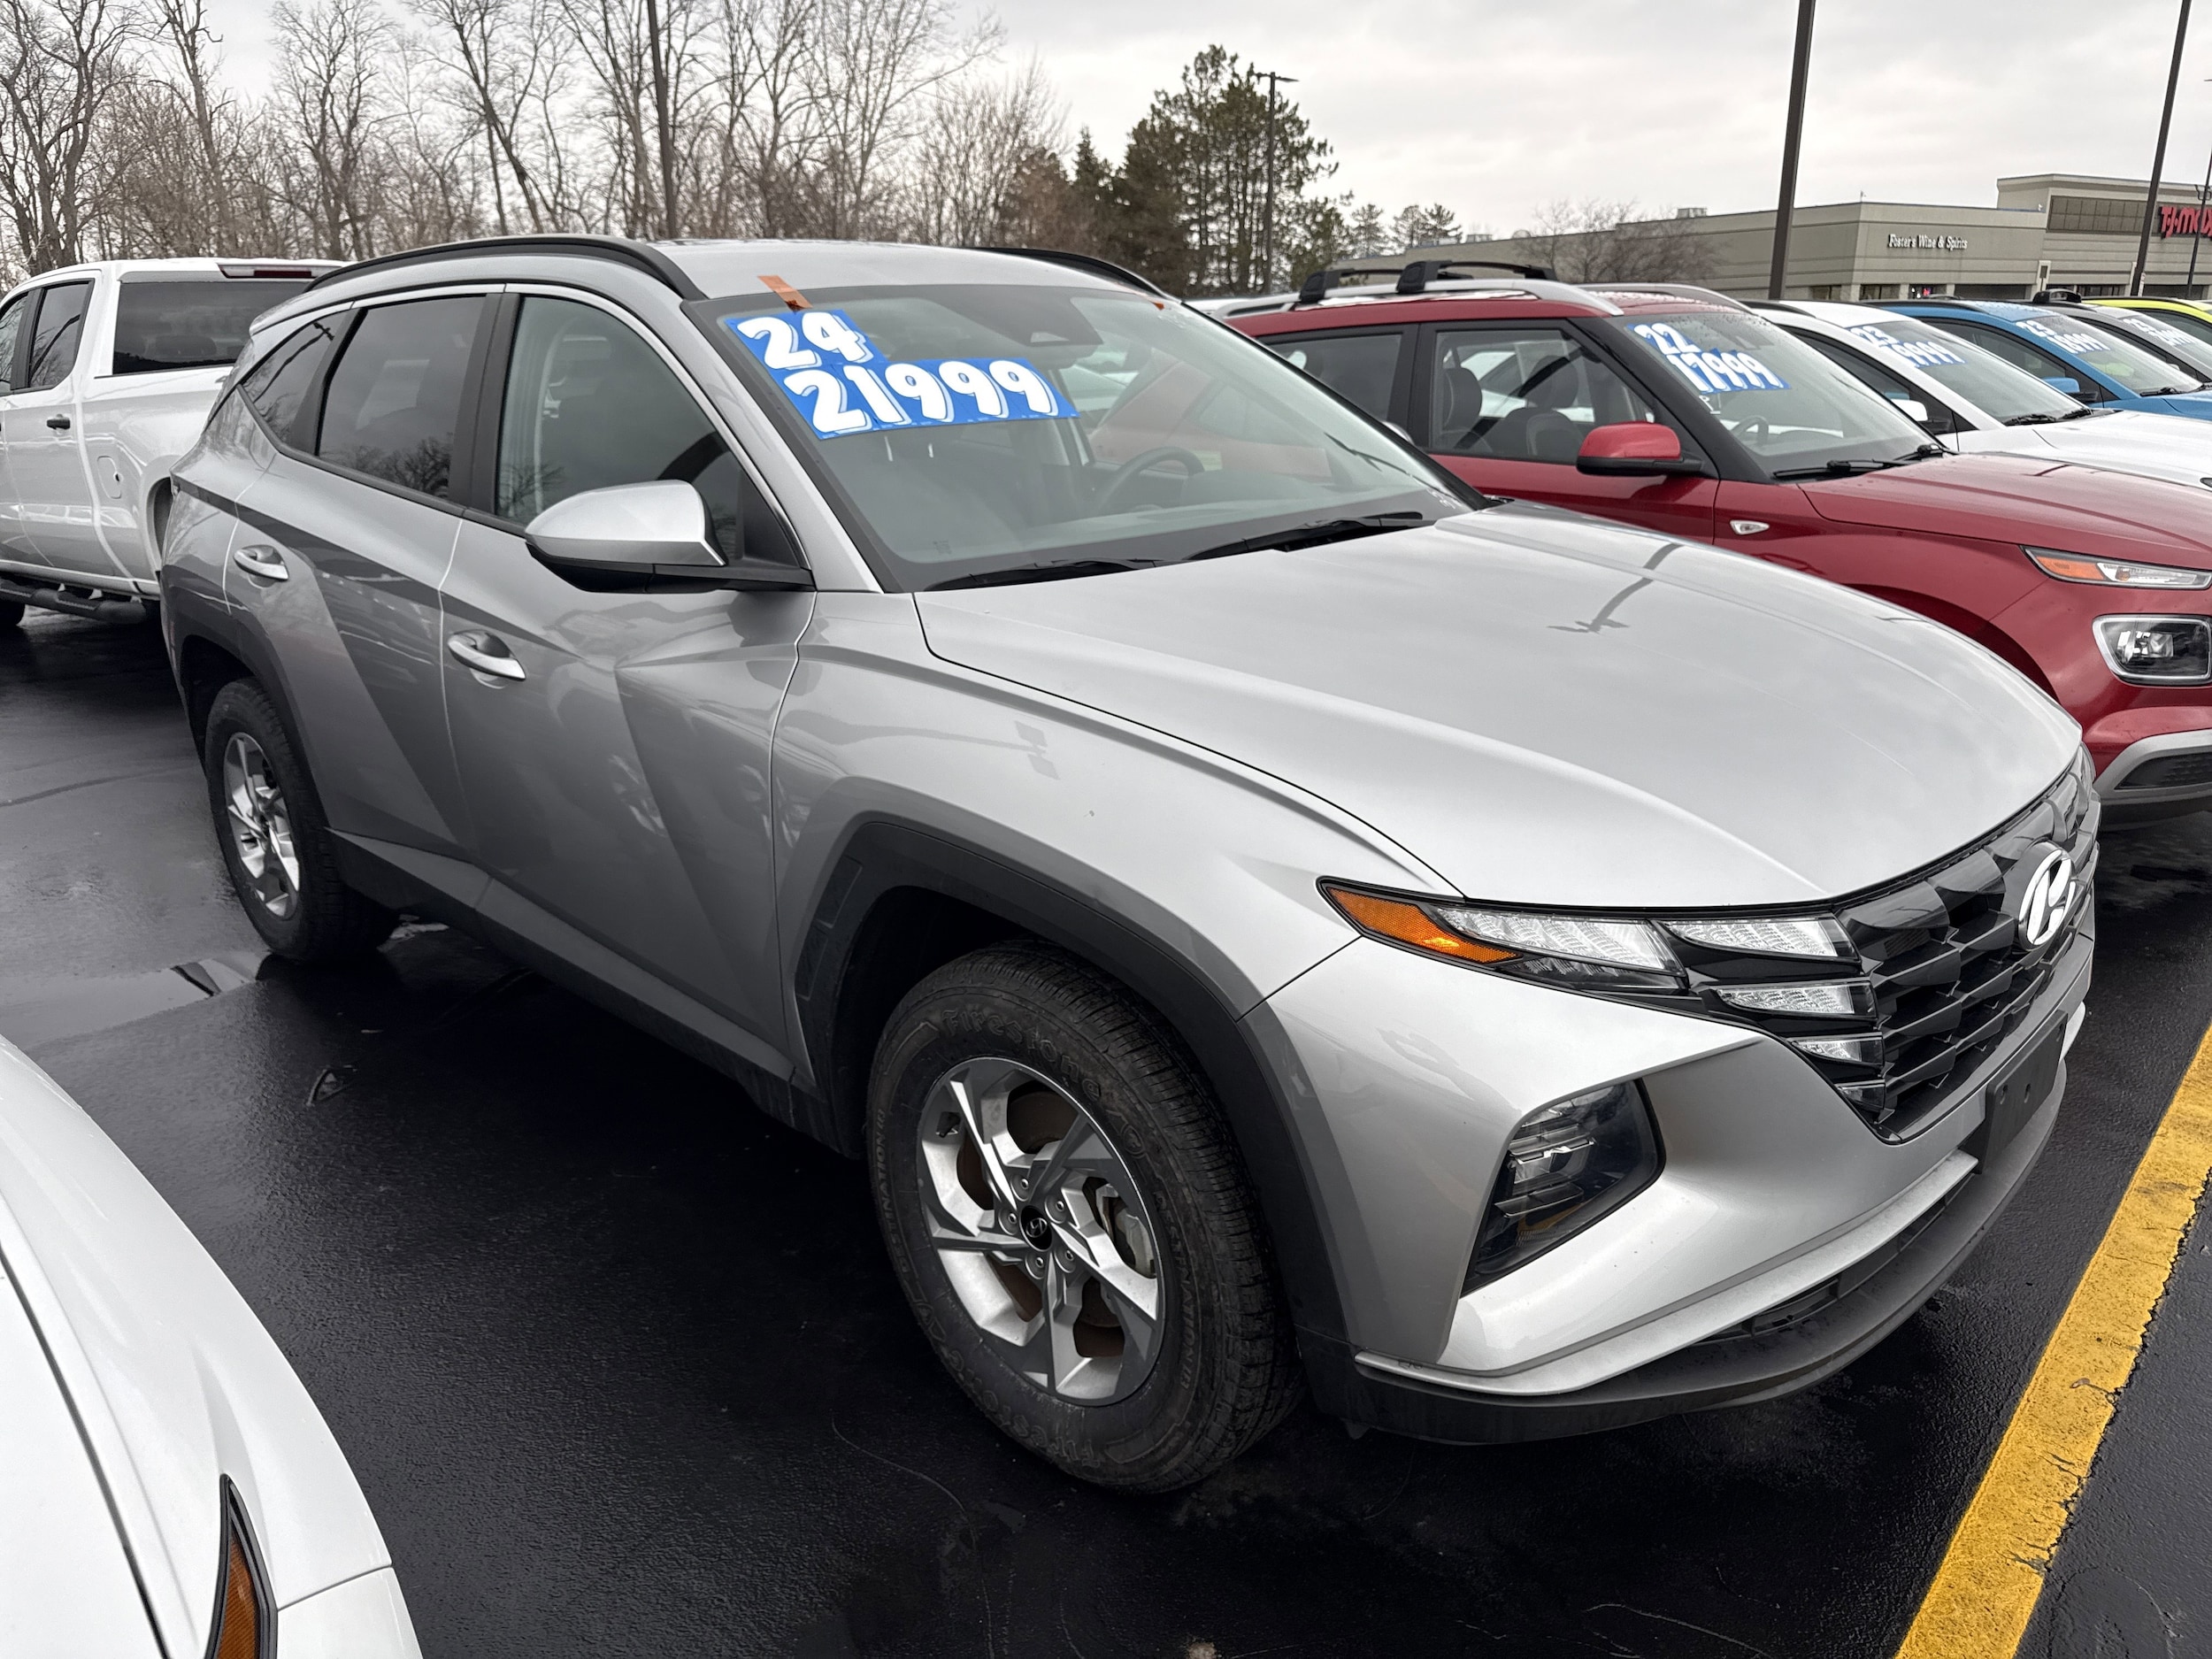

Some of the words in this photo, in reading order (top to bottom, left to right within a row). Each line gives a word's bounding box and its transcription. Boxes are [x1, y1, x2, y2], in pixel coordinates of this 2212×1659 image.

[1888, 234, 1916, 249] Foster's
[1916, 234, 1936, 249] Wine
[1937, 234, 1945, 249] &
[1946, 235, 1968, 251] Spirits
[737, 311, 873, 370] 24
[1633, 323, 1702, 355] 22
[1849, 325, 1901, 346] 23
[2016, 319, 2058, 337] 23
[2047, 333, 2111, 354] 18999
[1666, 352, 1785, 393] 17999
[783, 359, 1059, 434] 21999
[876, 1133, 910, 1273] DESTINATION
